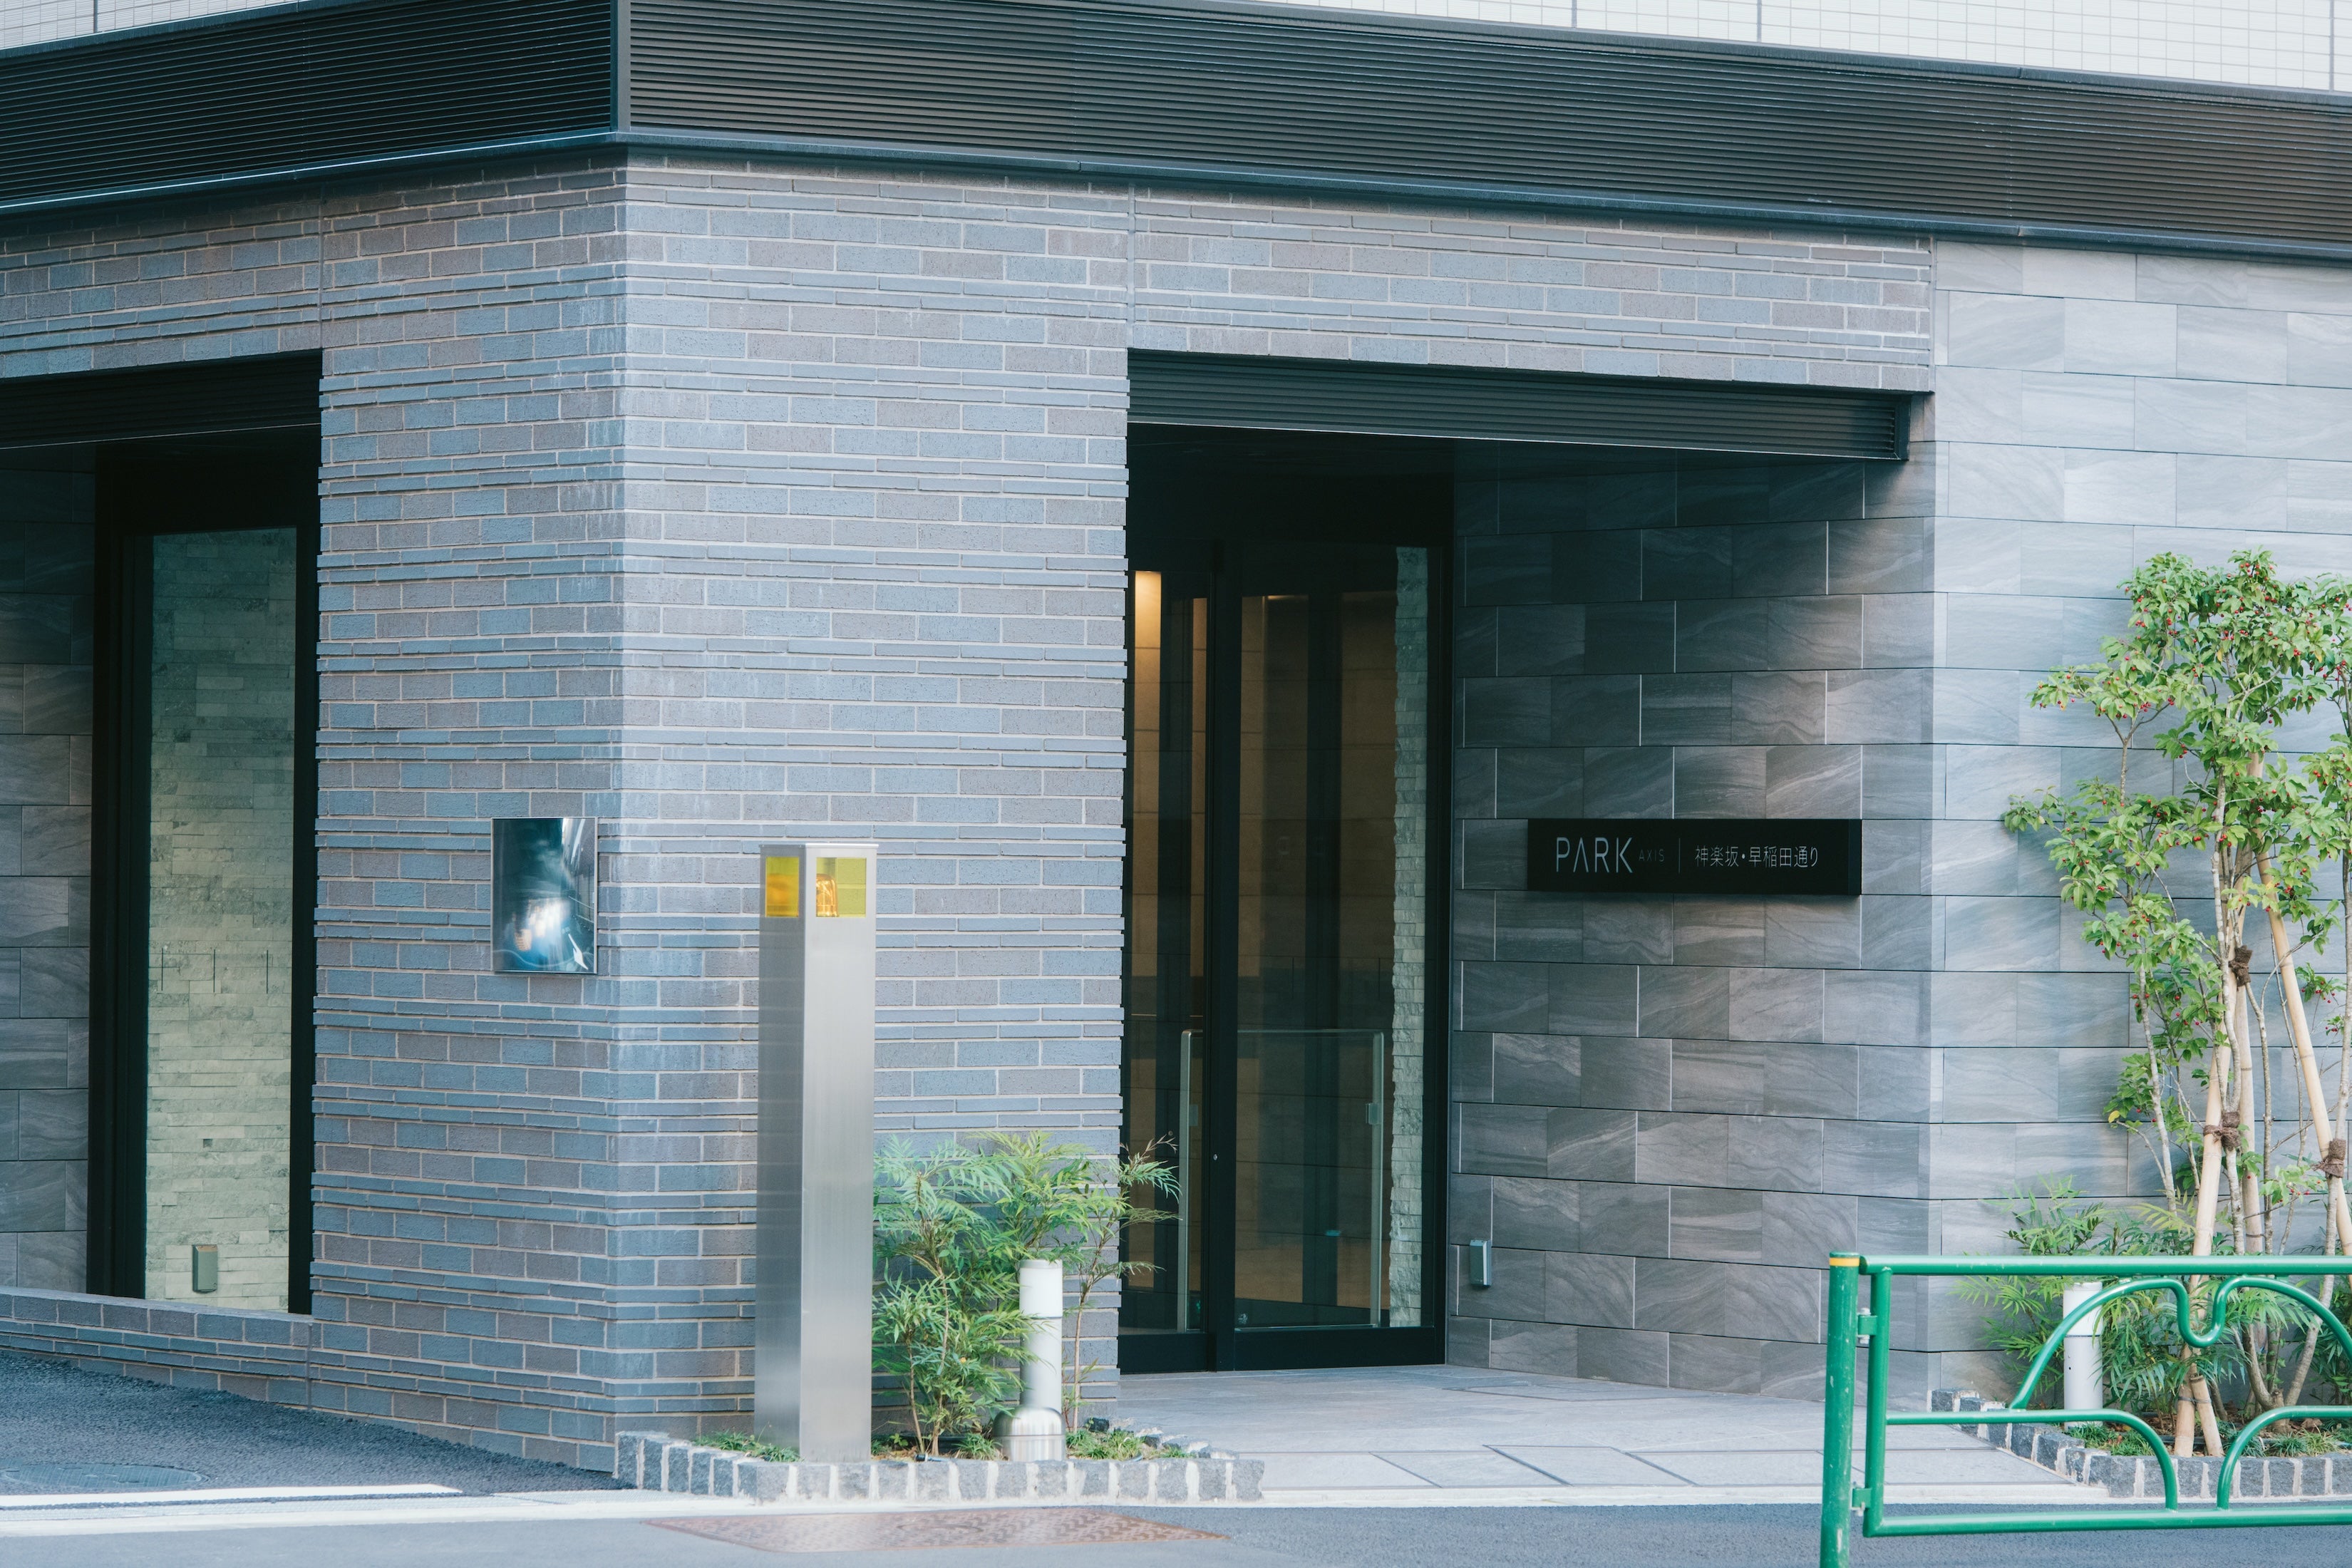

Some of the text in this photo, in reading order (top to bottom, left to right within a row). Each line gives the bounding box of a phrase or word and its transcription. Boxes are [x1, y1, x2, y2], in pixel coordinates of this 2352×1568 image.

[1556, 837, 1665, 873] PARK AXIS
[1695, 845, 1819, 868] 神楽坂・早稲田通り
